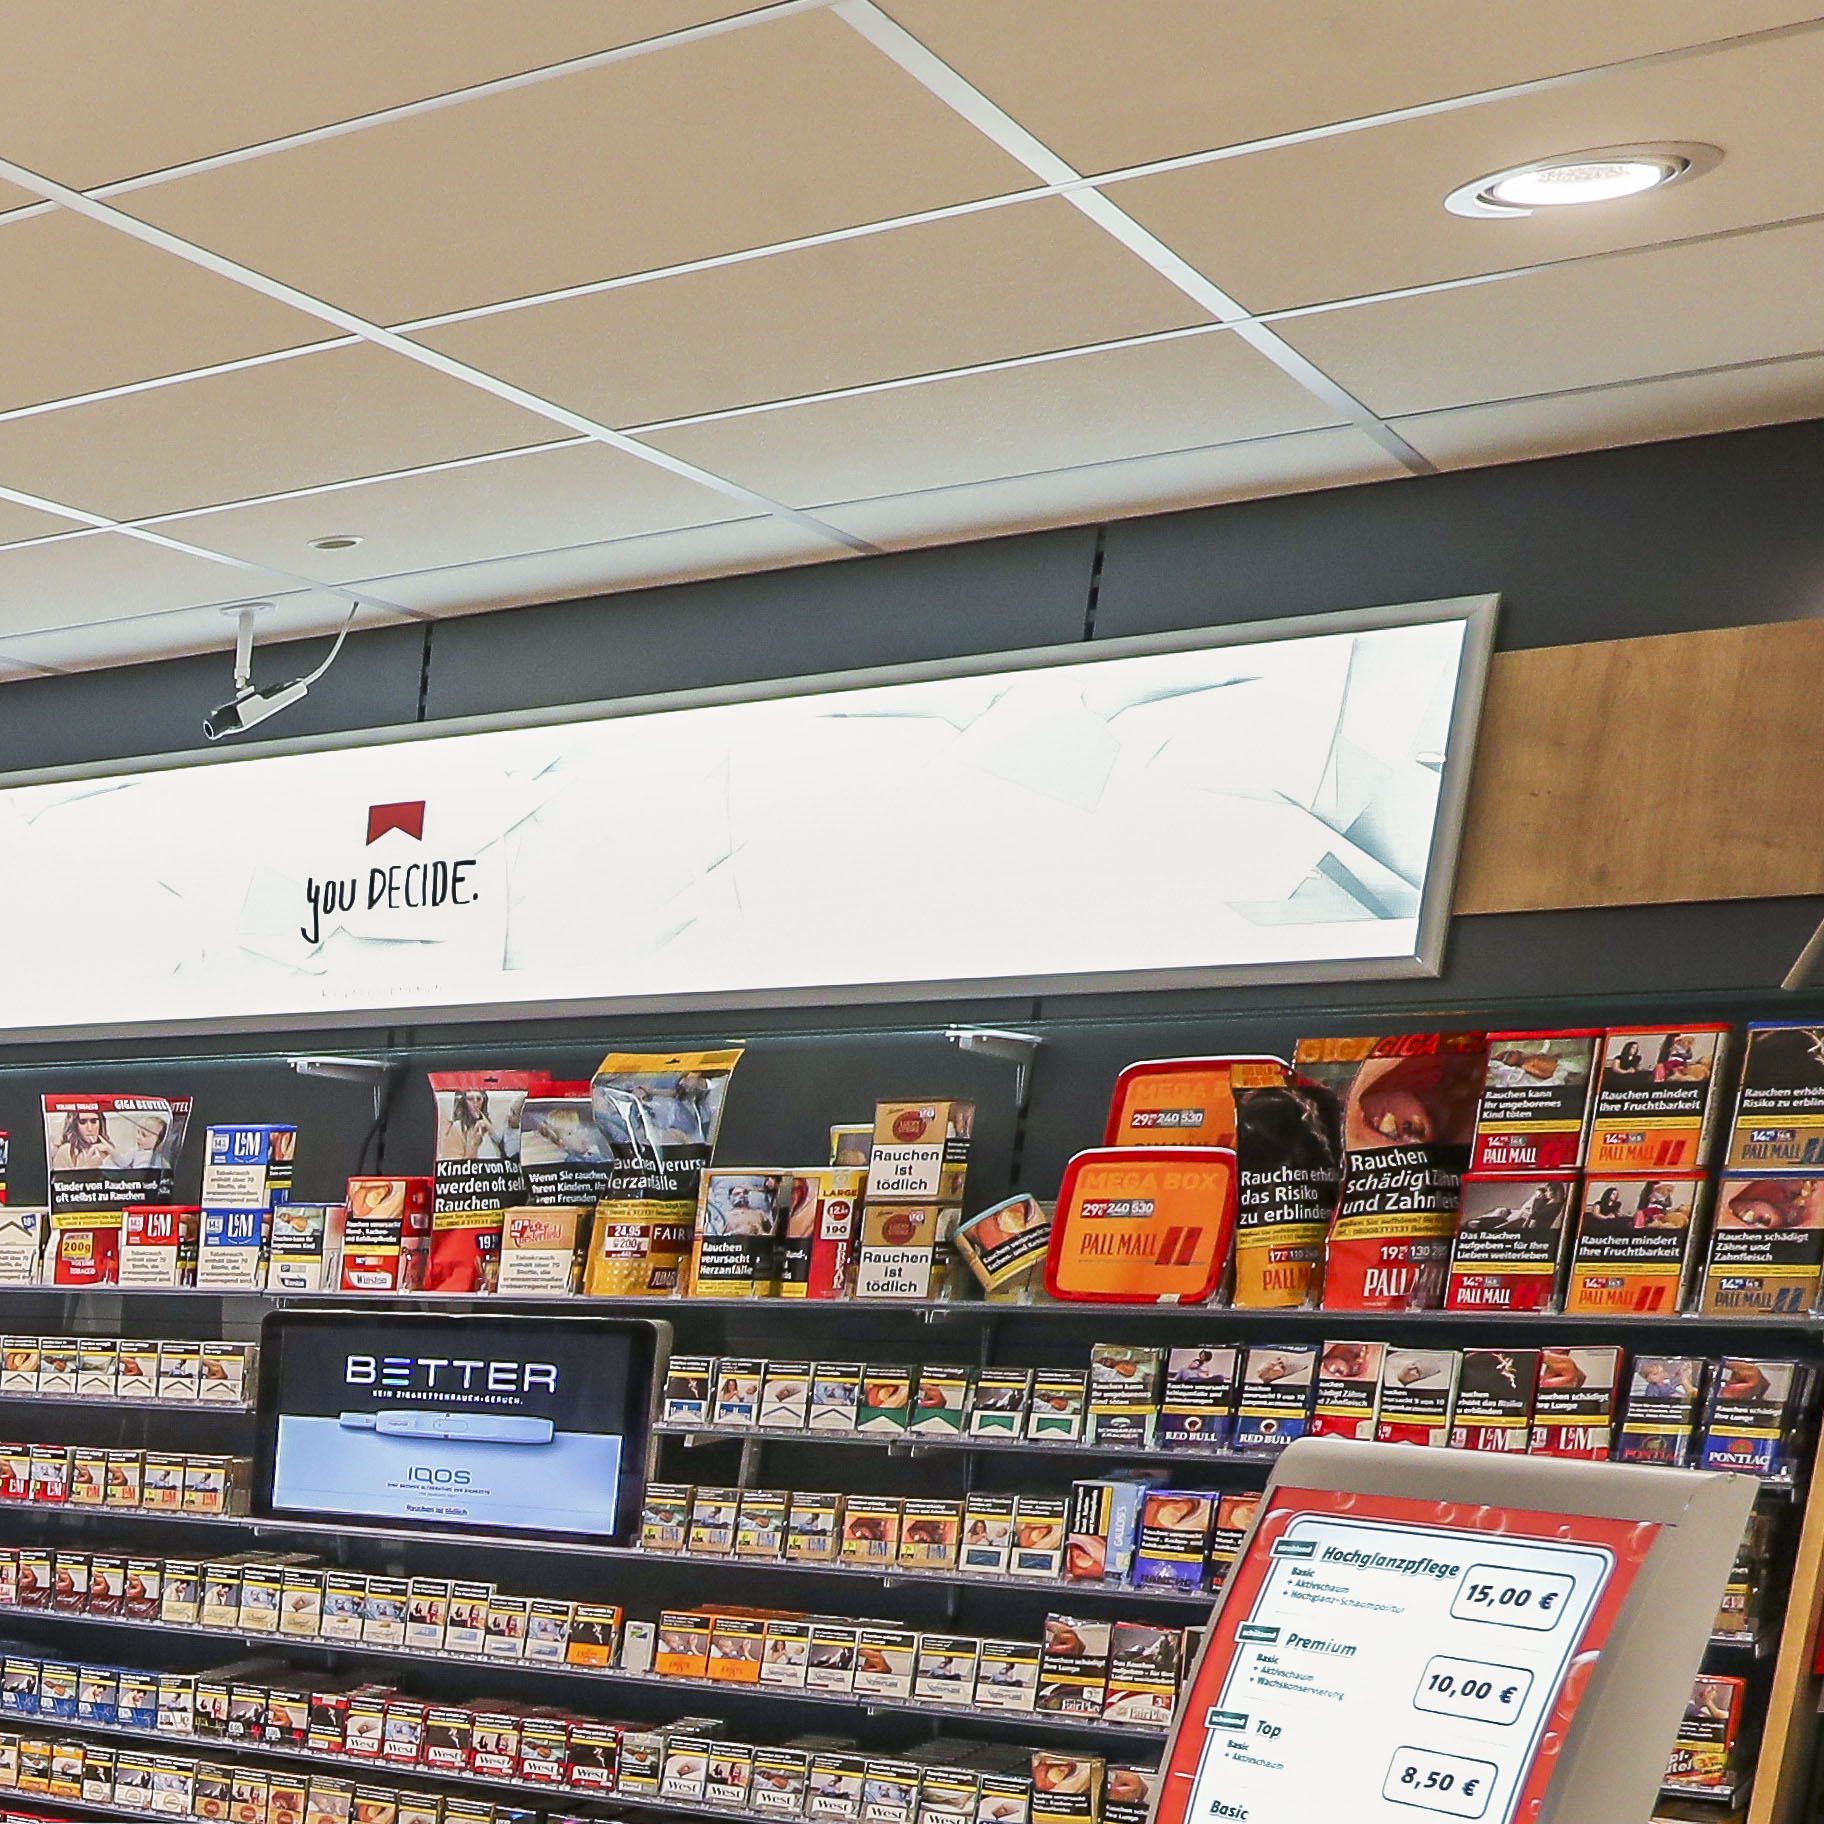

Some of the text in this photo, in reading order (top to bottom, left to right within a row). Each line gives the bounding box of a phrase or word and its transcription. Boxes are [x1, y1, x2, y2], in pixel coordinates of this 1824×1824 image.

[368, 860, 479, 910] DECIDE.
[1373, 1034, 1440, 1057] GIGA
[1601, 1088, 1698, 1100] Rauchen mindert
[1600, 1100, 1700, 1111] Ihre Fruchtbarkeit
[234, 1132, 261, 1156] L&M
[874, 1149, 939, 1162] Rauchen
[1351, 1150, 1427, 1172] Rauchen
[1599, 1145, 1654, 1161] PALL MALL
[437, 1160, 503, 1176] Kinder von
[895, 1164, 913, 1176] ist
[436, 1177, 504, 1194] werden oft
[876, 1178, 928, 1191] tödlich
[1085, 1172, 1218, 1190] MEGA BOX
[1241, 1168, 1308, 1186] Rauchen
[1347, 1171, 1432, 1194] schädigt
[823, 1189, 857, 1198] LARGE
[1242, 1186, 1318, 1206] das Risiko
[1343, 1194, 1382, 1215] und
[148, 1213, 171, 1237] L&M
[1240, 1210, 1258, 1226] zu
[1080, 1232, 1157, 1256] PALL MALL
[1718, 1231, 1808, 1243] Rauchen schädigt
[64, 1241, 91, 1253] 200g
[1716, 1242, 1770, 1252] Zähne und
[1714, 1252, 1773, 1262] Zahnfleisch
[344, 1354, 560, 1395] BETTER
[1239, 1434, 1293, 1444] RED BULL
[1709, 1451, 1770, 1465] PONTIAC
[407, 1466, 471, 1486] IQOS
[1321, 1545, 1559, 1610] Hochglanzpflege 15,00 €
[1285, 1632, 1518, 1704] Premium 10,00 €
[1256, 1719, 1480, 1797] Top 8,50 €
[757, 1792, 792, 1807] West
[1210, 1799, 1249, 1821] Basic
